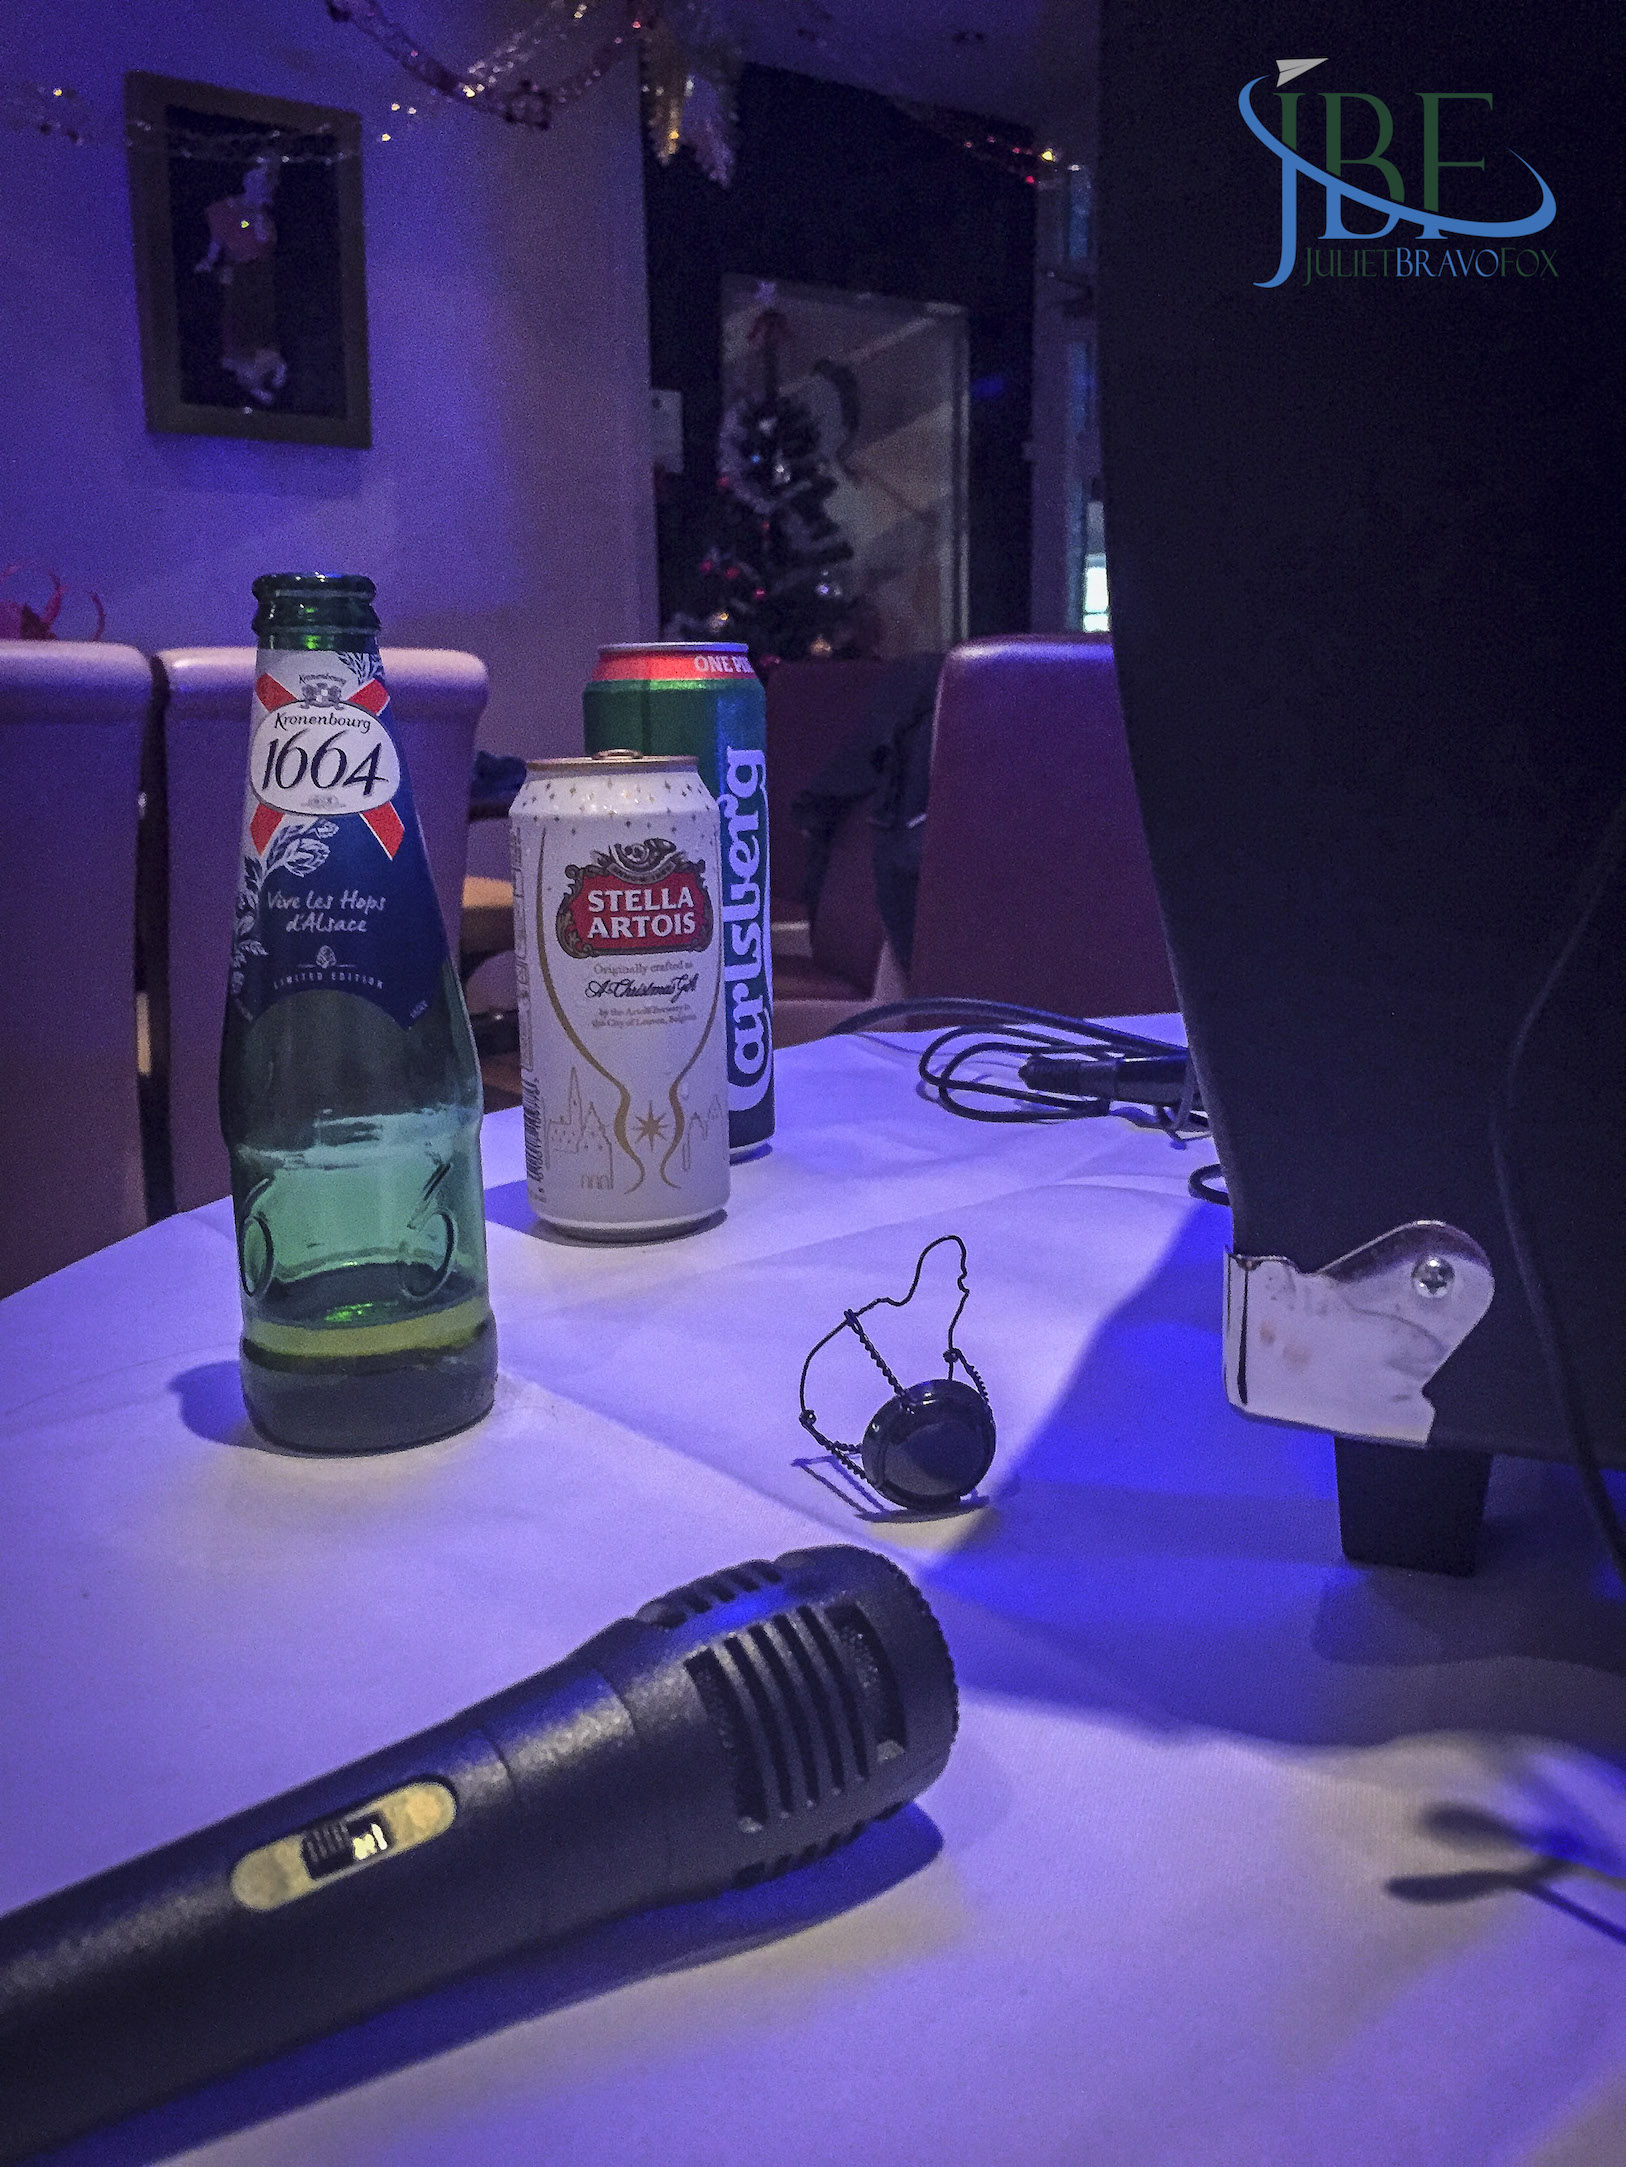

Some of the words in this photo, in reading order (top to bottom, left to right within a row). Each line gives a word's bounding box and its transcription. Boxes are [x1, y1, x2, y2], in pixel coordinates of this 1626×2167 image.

[694, 655, 733, 673] ONE
[274, 712, 371, 734] Kronenbourg
[261, 728, 389, 796] 1664
[338, 889, 387, 915] Hops
[587, 886, 695, 913] STELLA
[285, 912, 368, 933] d'Alsace
[587, 912, 696, 939] ARTOIS
[273, 972, 323, 990] LIMITED
[331, 972, 383, 990] EDITION
